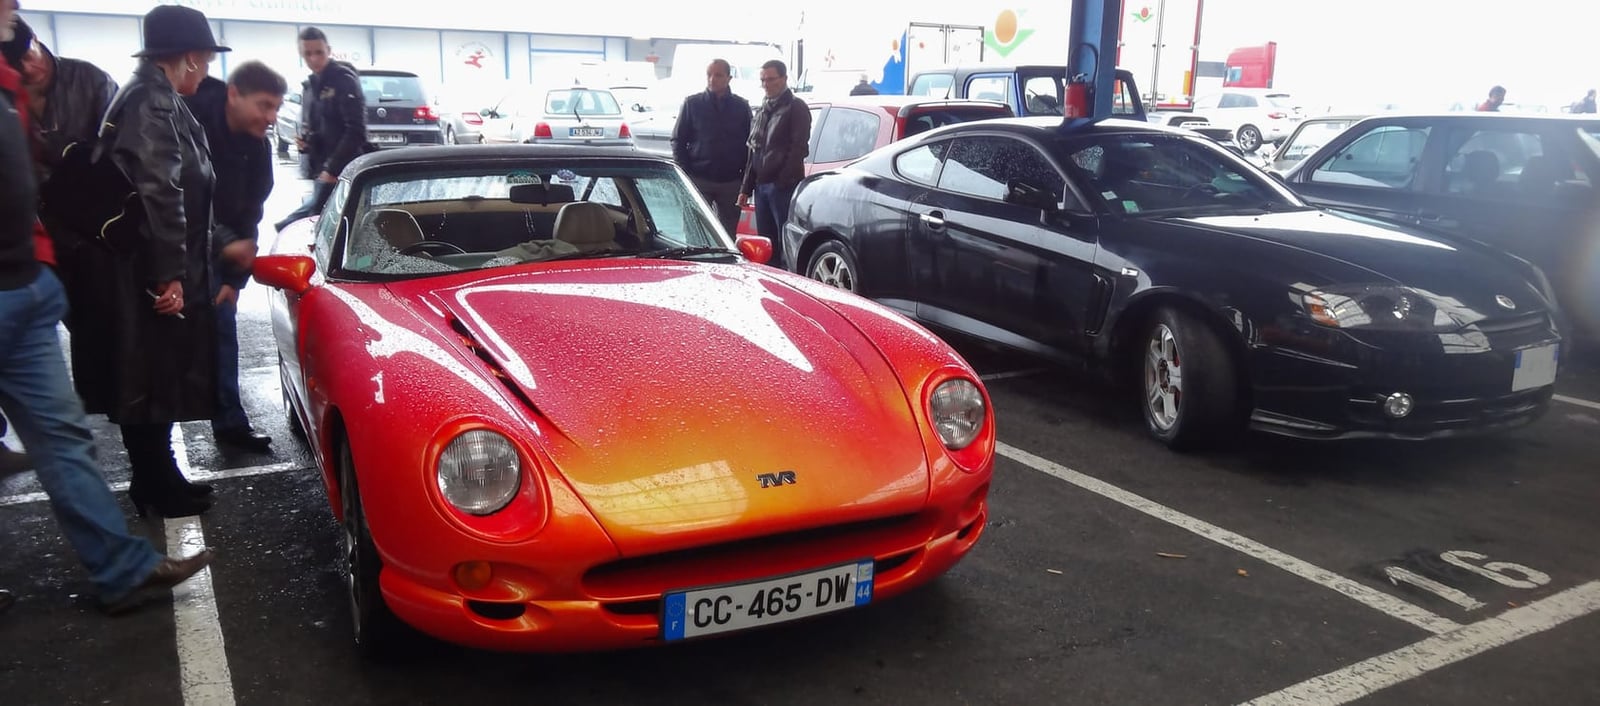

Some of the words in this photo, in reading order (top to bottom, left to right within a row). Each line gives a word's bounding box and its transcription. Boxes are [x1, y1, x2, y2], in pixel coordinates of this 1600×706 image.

[756, 470, 797, 489] TVR
[672, 620, 679, 631] F
[693, 572, 851, 628] CC-465-DW
[857, 583, 871, 600] 44
[1384, 550, 1552, 611] 16
